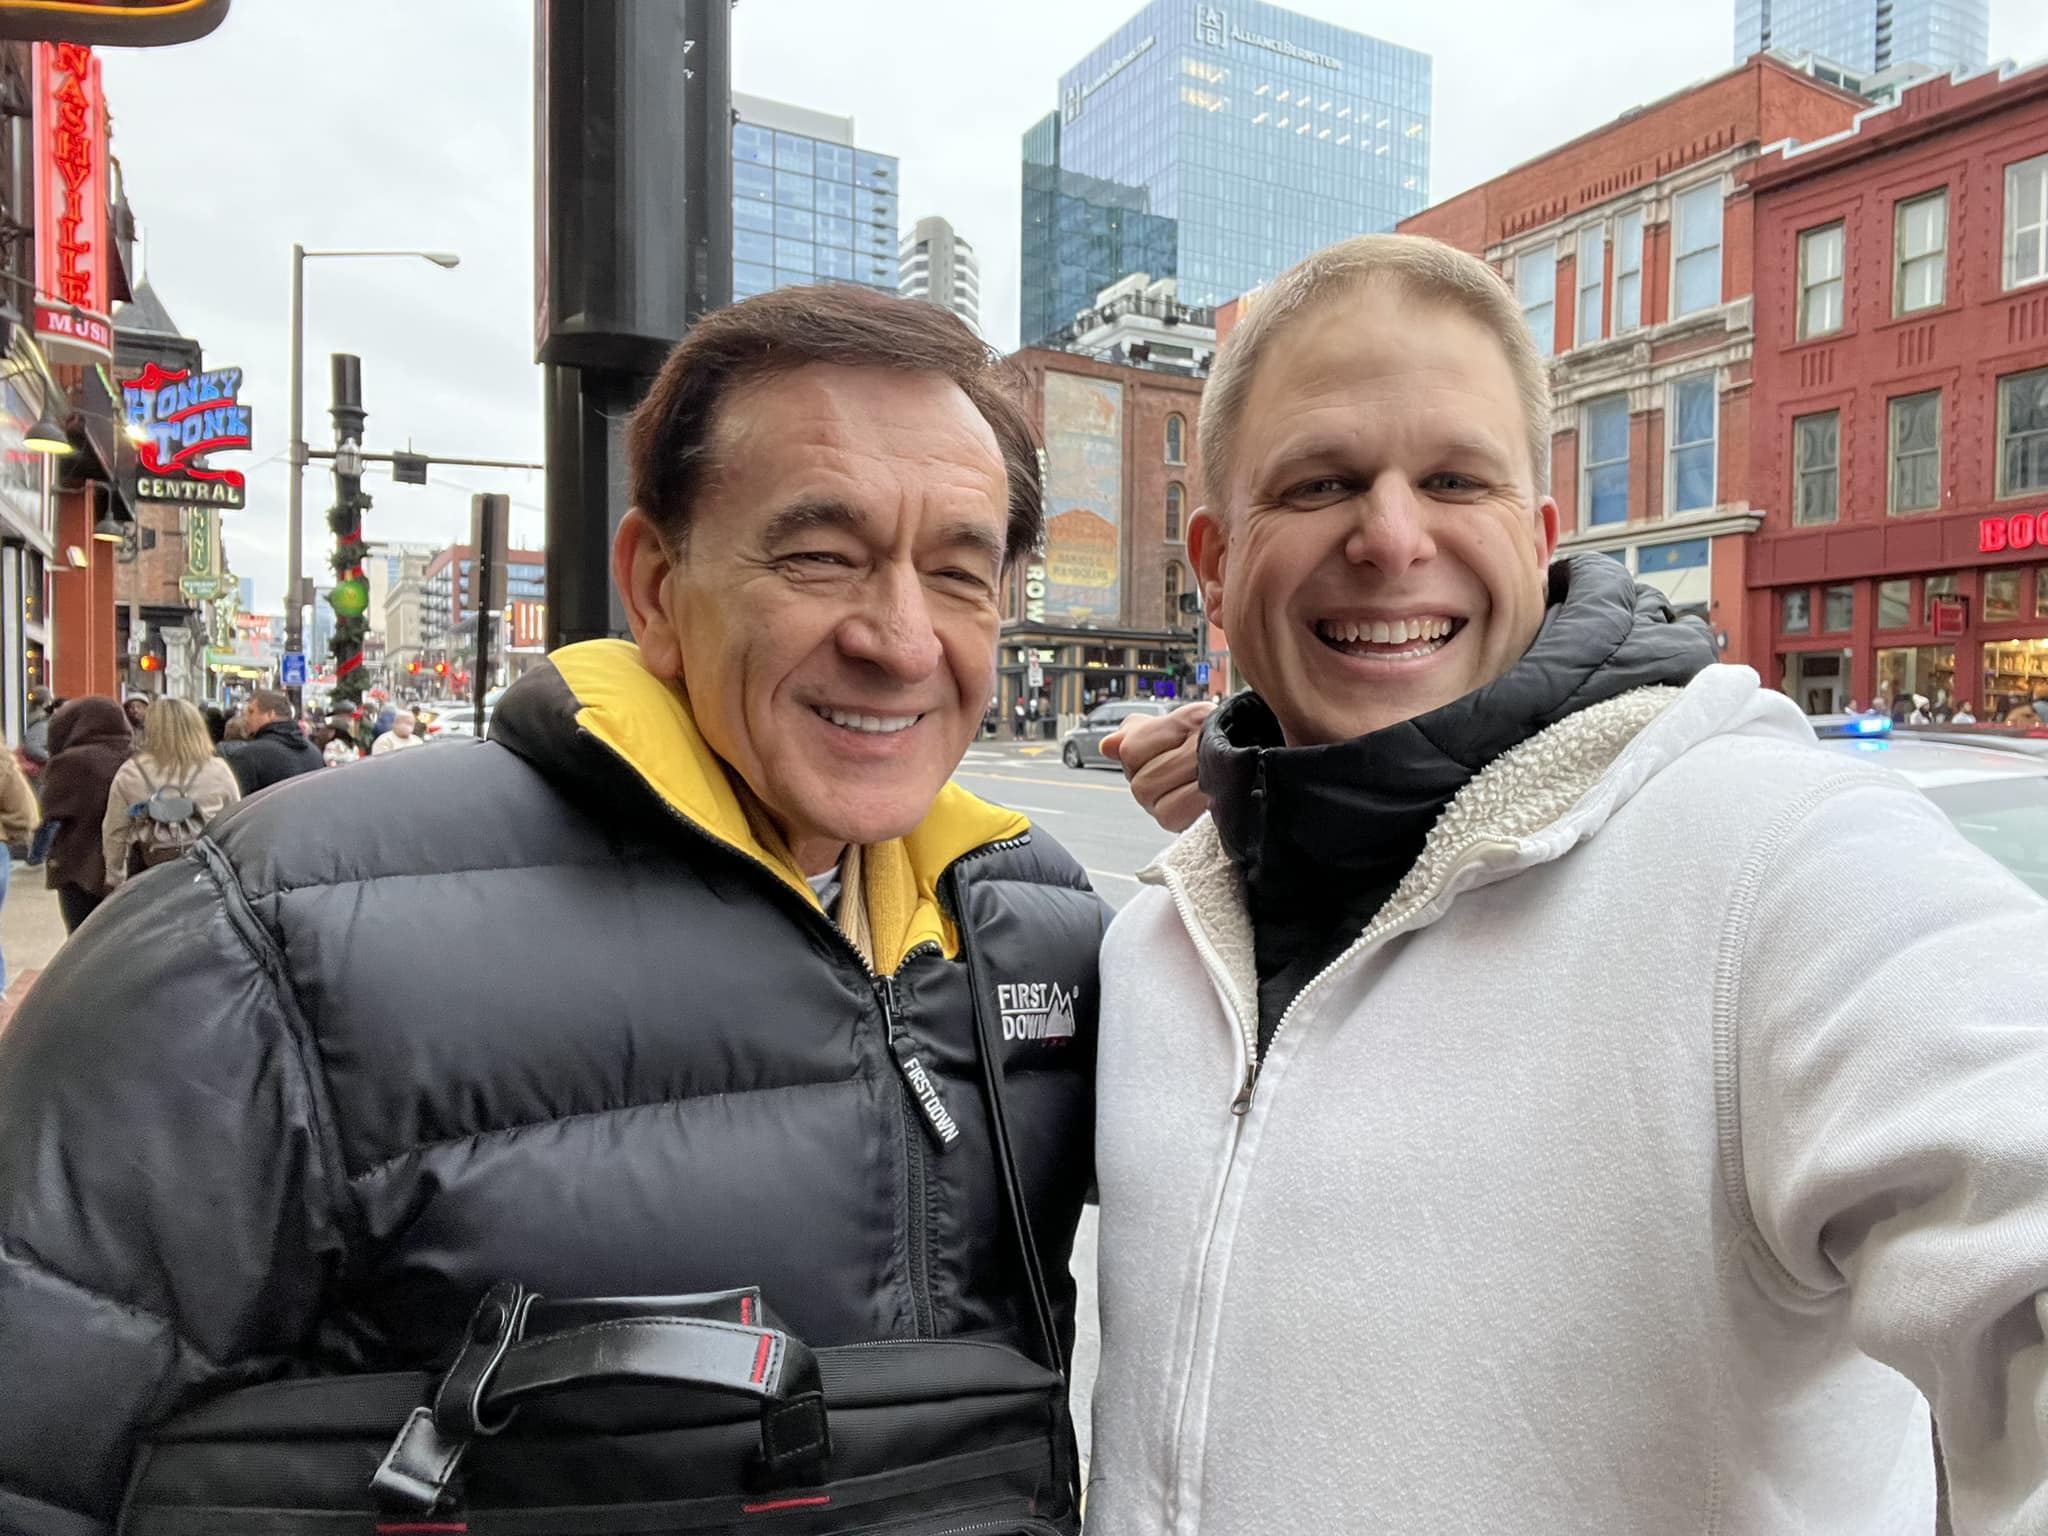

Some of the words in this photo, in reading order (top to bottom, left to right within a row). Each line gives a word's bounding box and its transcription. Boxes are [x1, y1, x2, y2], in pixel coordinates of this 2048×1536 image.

[55, 42, 91, 310] NASHVILLE
[124, 369, 238, 426] HONKY
[147, 406, 248, 465] TONK
[137, 478, 240, 503] CENTRAL
[1026, 565, 1046, 623] ROW
[997, 983, 1047, 1009] FIRST
[1001, 1014, 1047, 1041] DOWN
